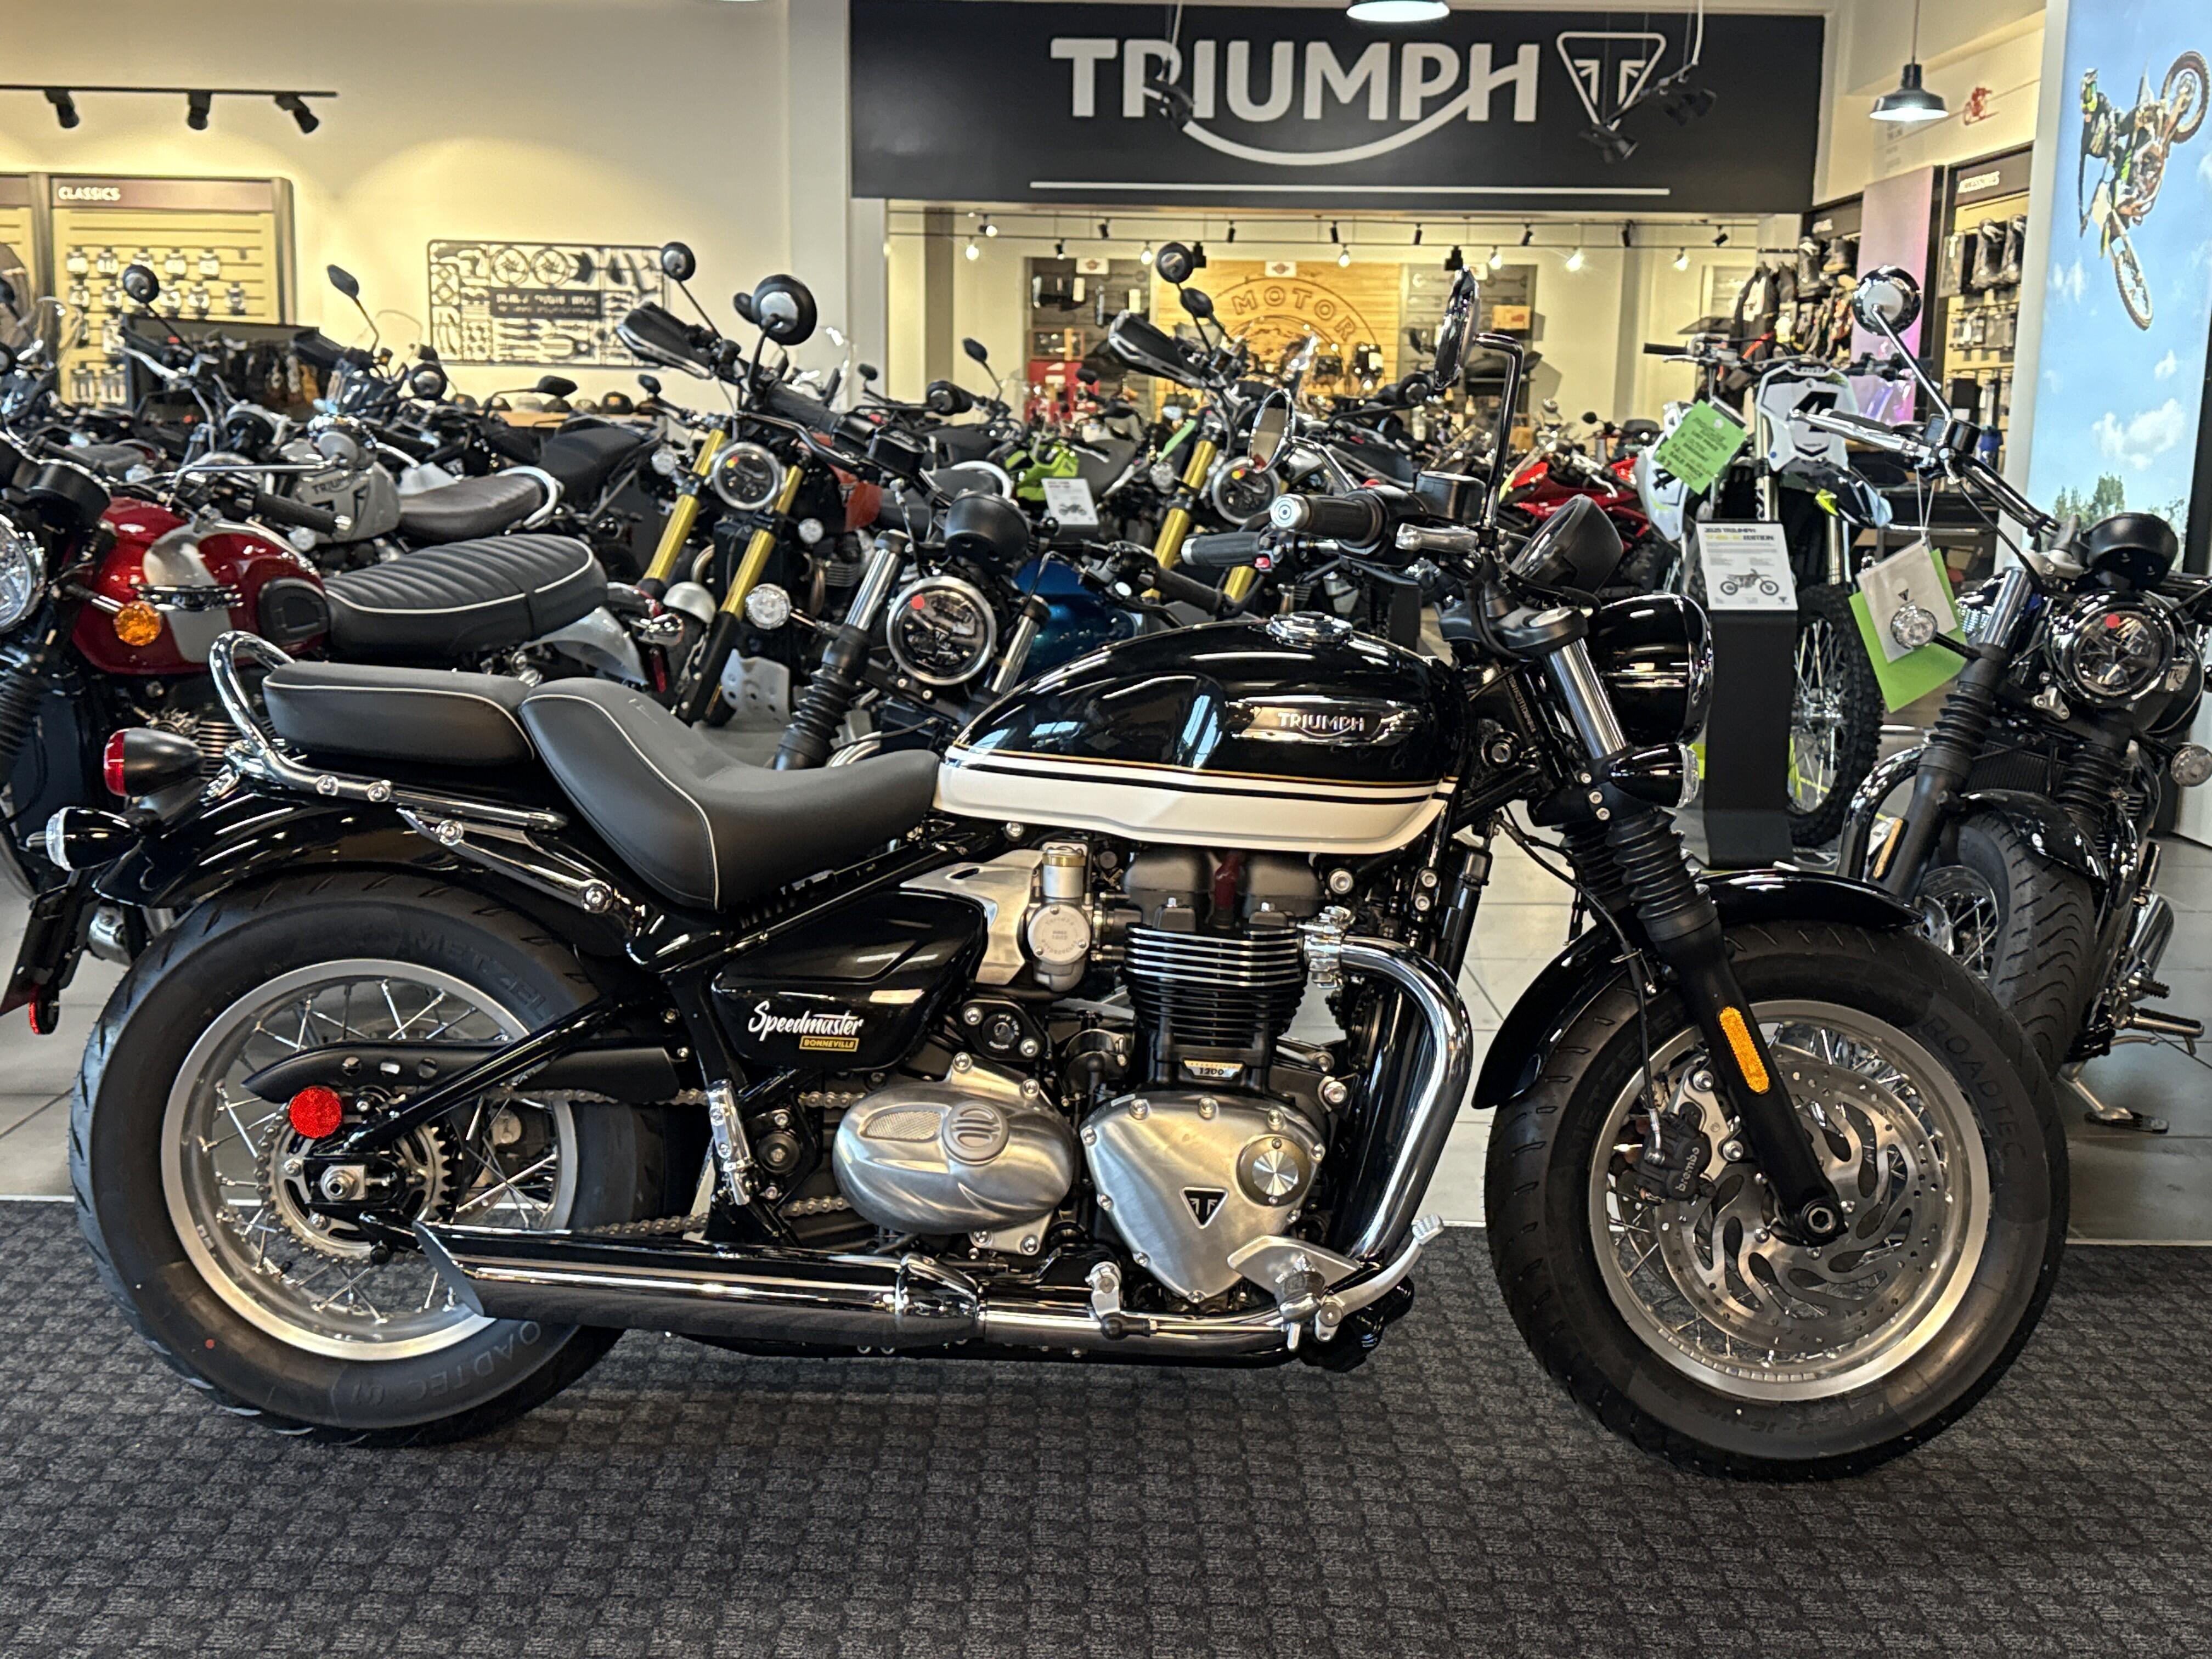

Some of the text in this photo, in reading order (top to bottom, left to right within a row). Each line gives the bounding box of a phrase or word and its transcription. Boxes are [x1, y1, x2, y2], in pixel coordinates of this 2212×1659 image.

[1050, 37, 1539, 166] TRIUMPH
[58, 187, 121, 201] CLASSICS
[1231, 285, 1357, 342] MOTOR
[1278, 712, 1365, 737] TRIUMPH
[415, 931, 557, 1021] METZEL
[748, 1000, 865, 1042] Speedmaster
[804, 1039, 854, 1048] BONNEVILLE
[1675, 1147, 1700, 1192] brembo
[408, 1321, 541, 1402] OADTEC
